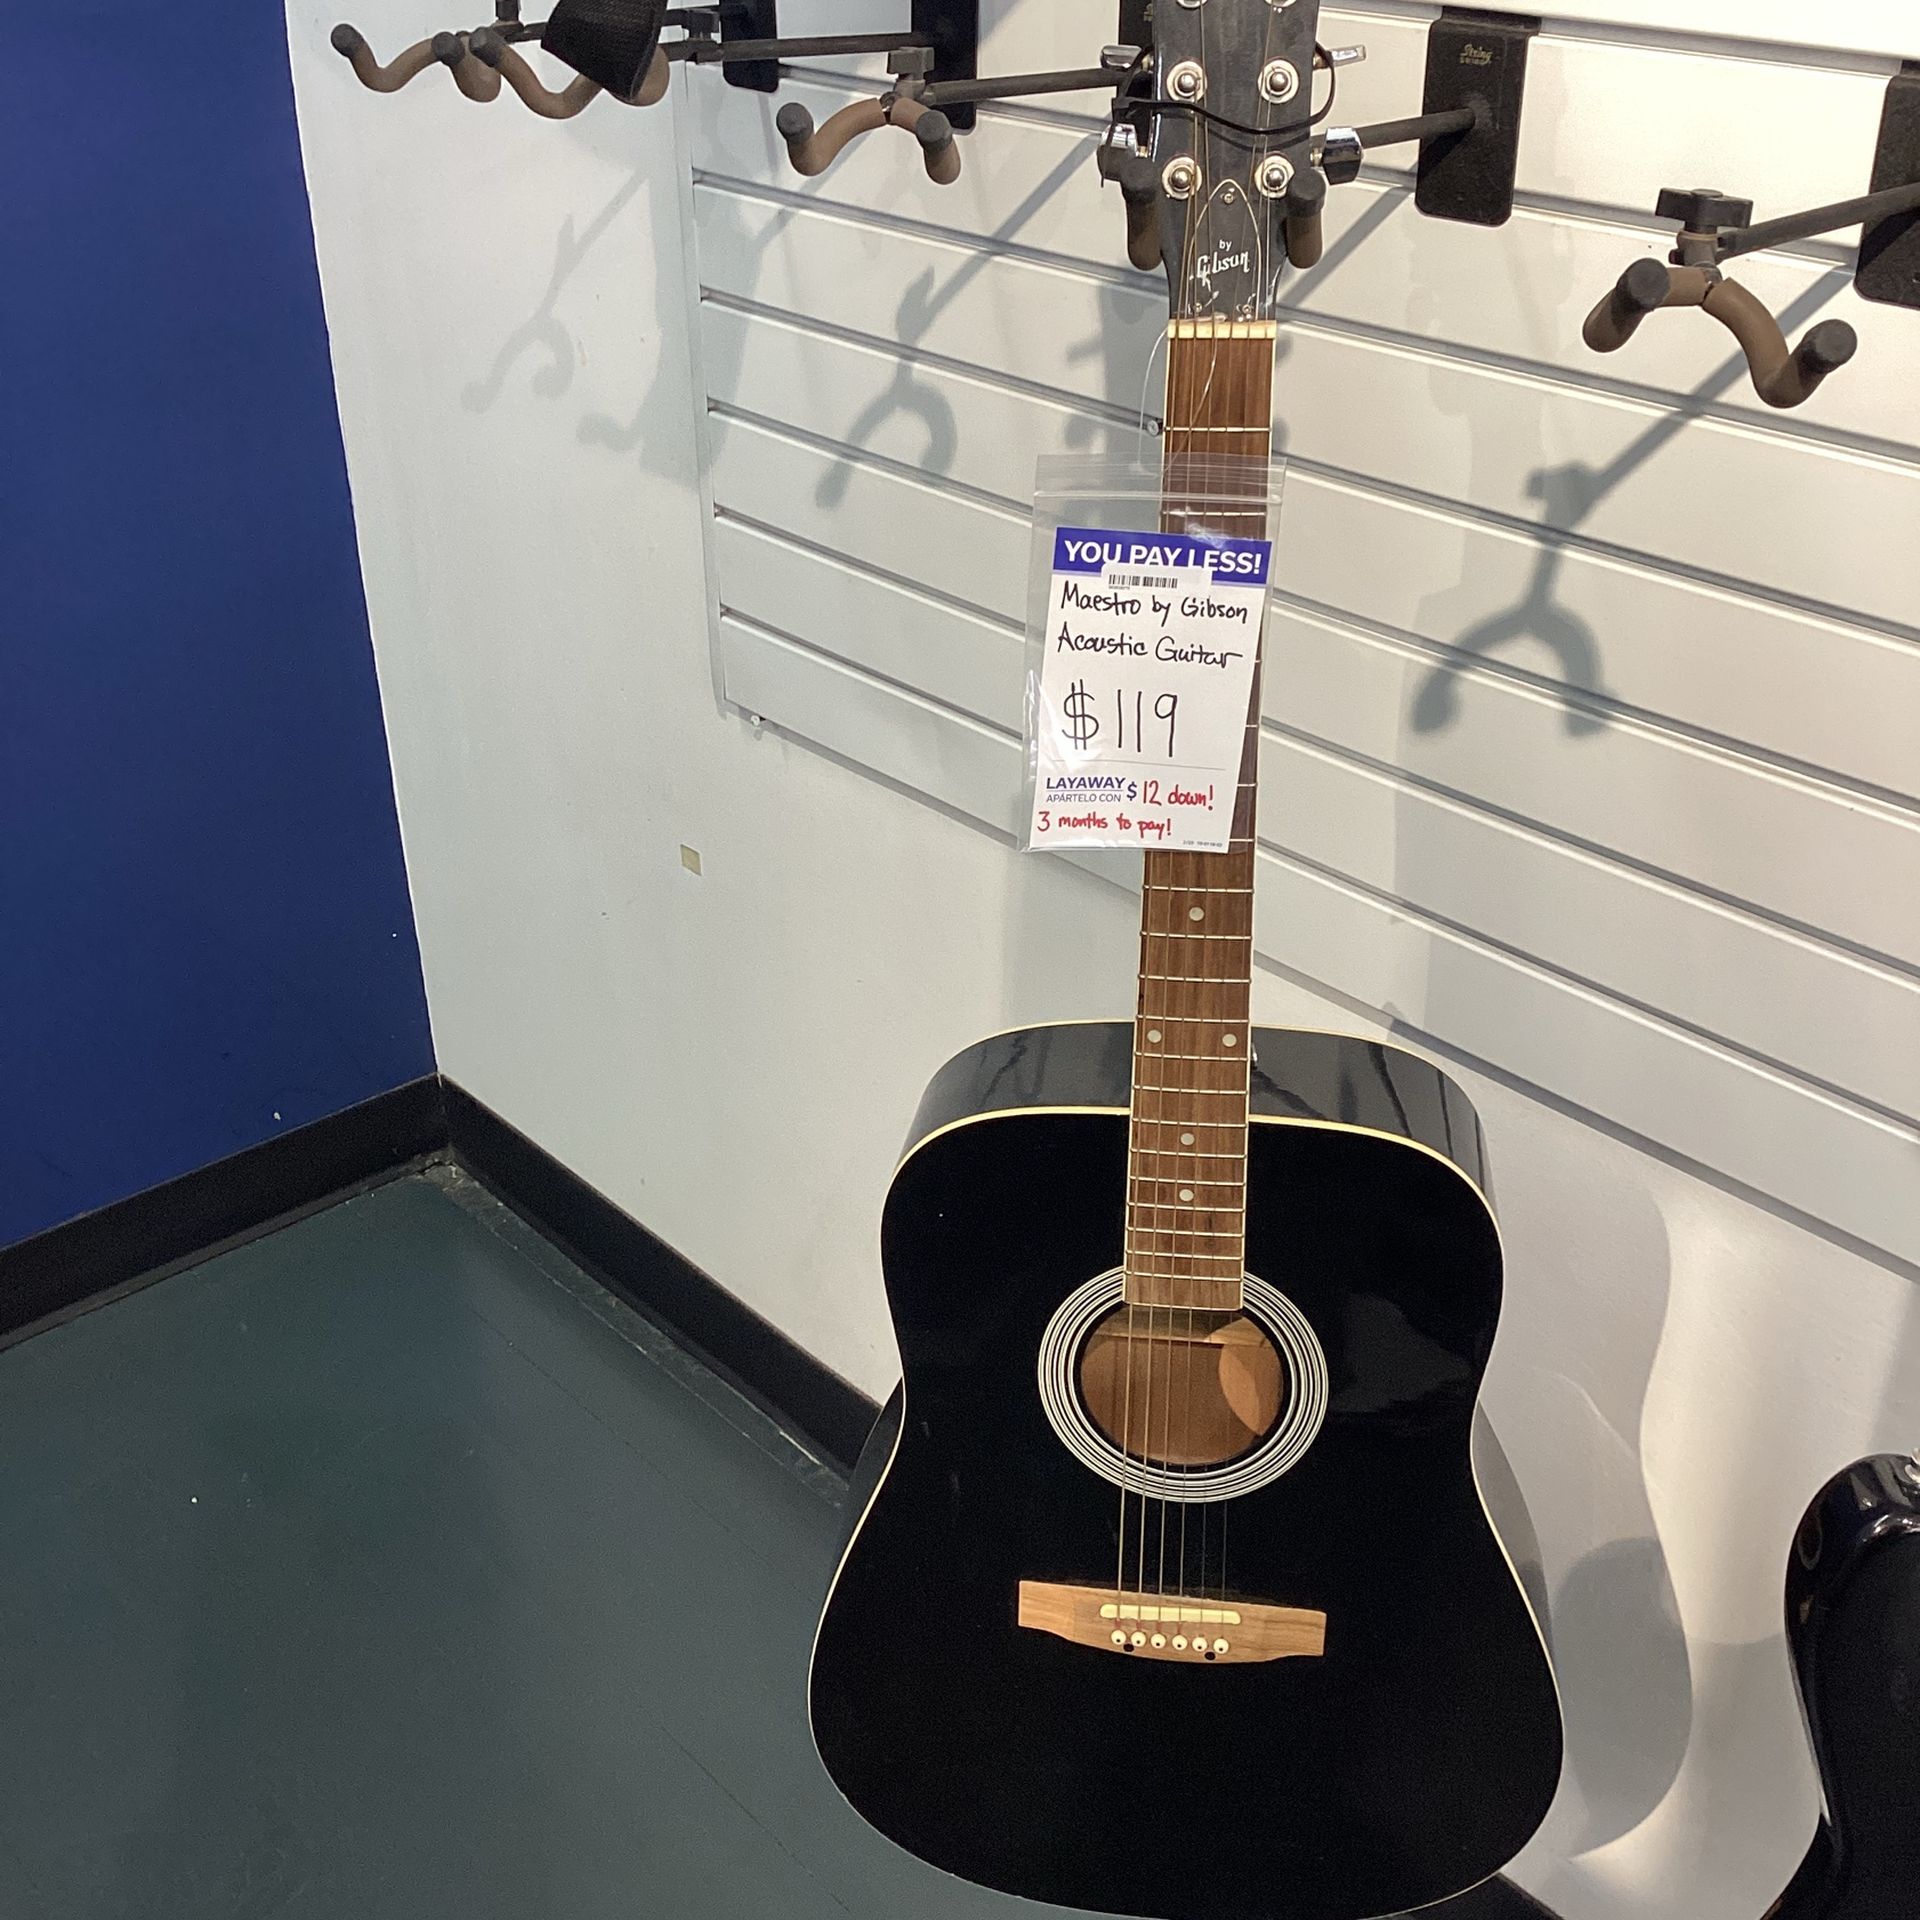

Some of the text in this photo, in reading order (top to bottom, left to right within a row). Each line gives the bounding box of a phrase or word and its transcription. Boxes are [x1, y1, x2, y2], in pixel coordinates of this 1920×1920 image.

[1219, 239, 1232, 252] by
[1196, 251, 1250, 287] Gibson
[1064, 540, 1262, 574] YOU PAY LESS!
[1060, 580, 1248, 627] Maestro by Gibson
[1057, 621, 1243, 668] Acoustic Guitar
[1046, 776, 1126, 790] LAYAWAY
[1167, 784, 1214, 811] down!
[1046, 793, 1122, 803] APÁRTELO CON
[1037, 811, 1172, 840] 3 months to pay!
